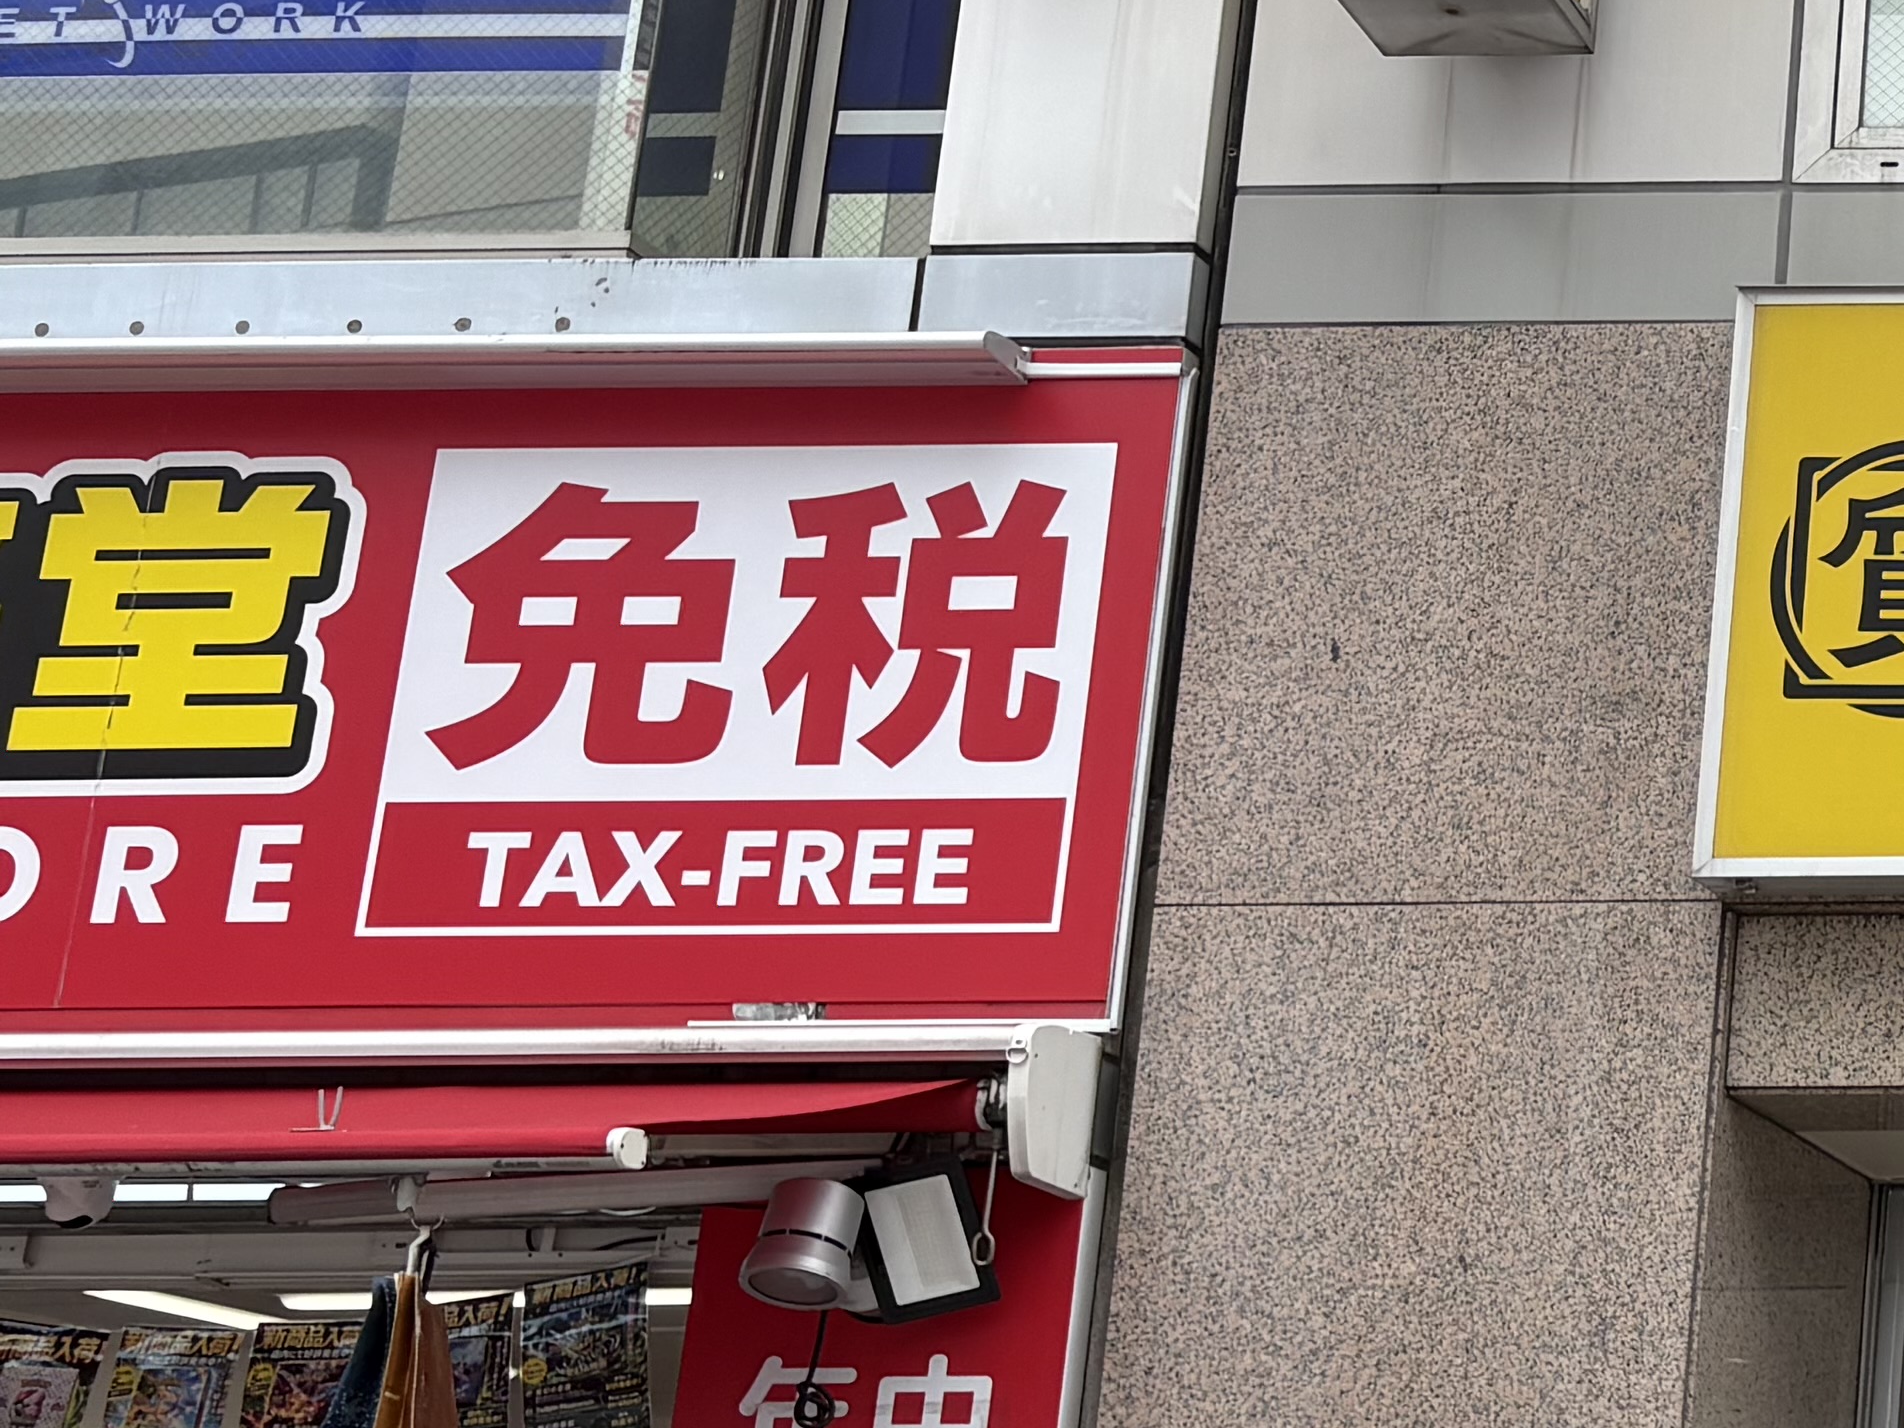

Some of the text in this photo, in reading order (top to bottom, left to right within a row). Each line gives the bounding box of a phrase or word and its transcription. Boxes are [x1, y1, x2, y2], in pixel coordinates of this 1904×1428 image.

[0, 478, 331, 751] 堂
[425, 478, 1069, 771] 免税
[466, 827, 976, 909] TAX-FREE
